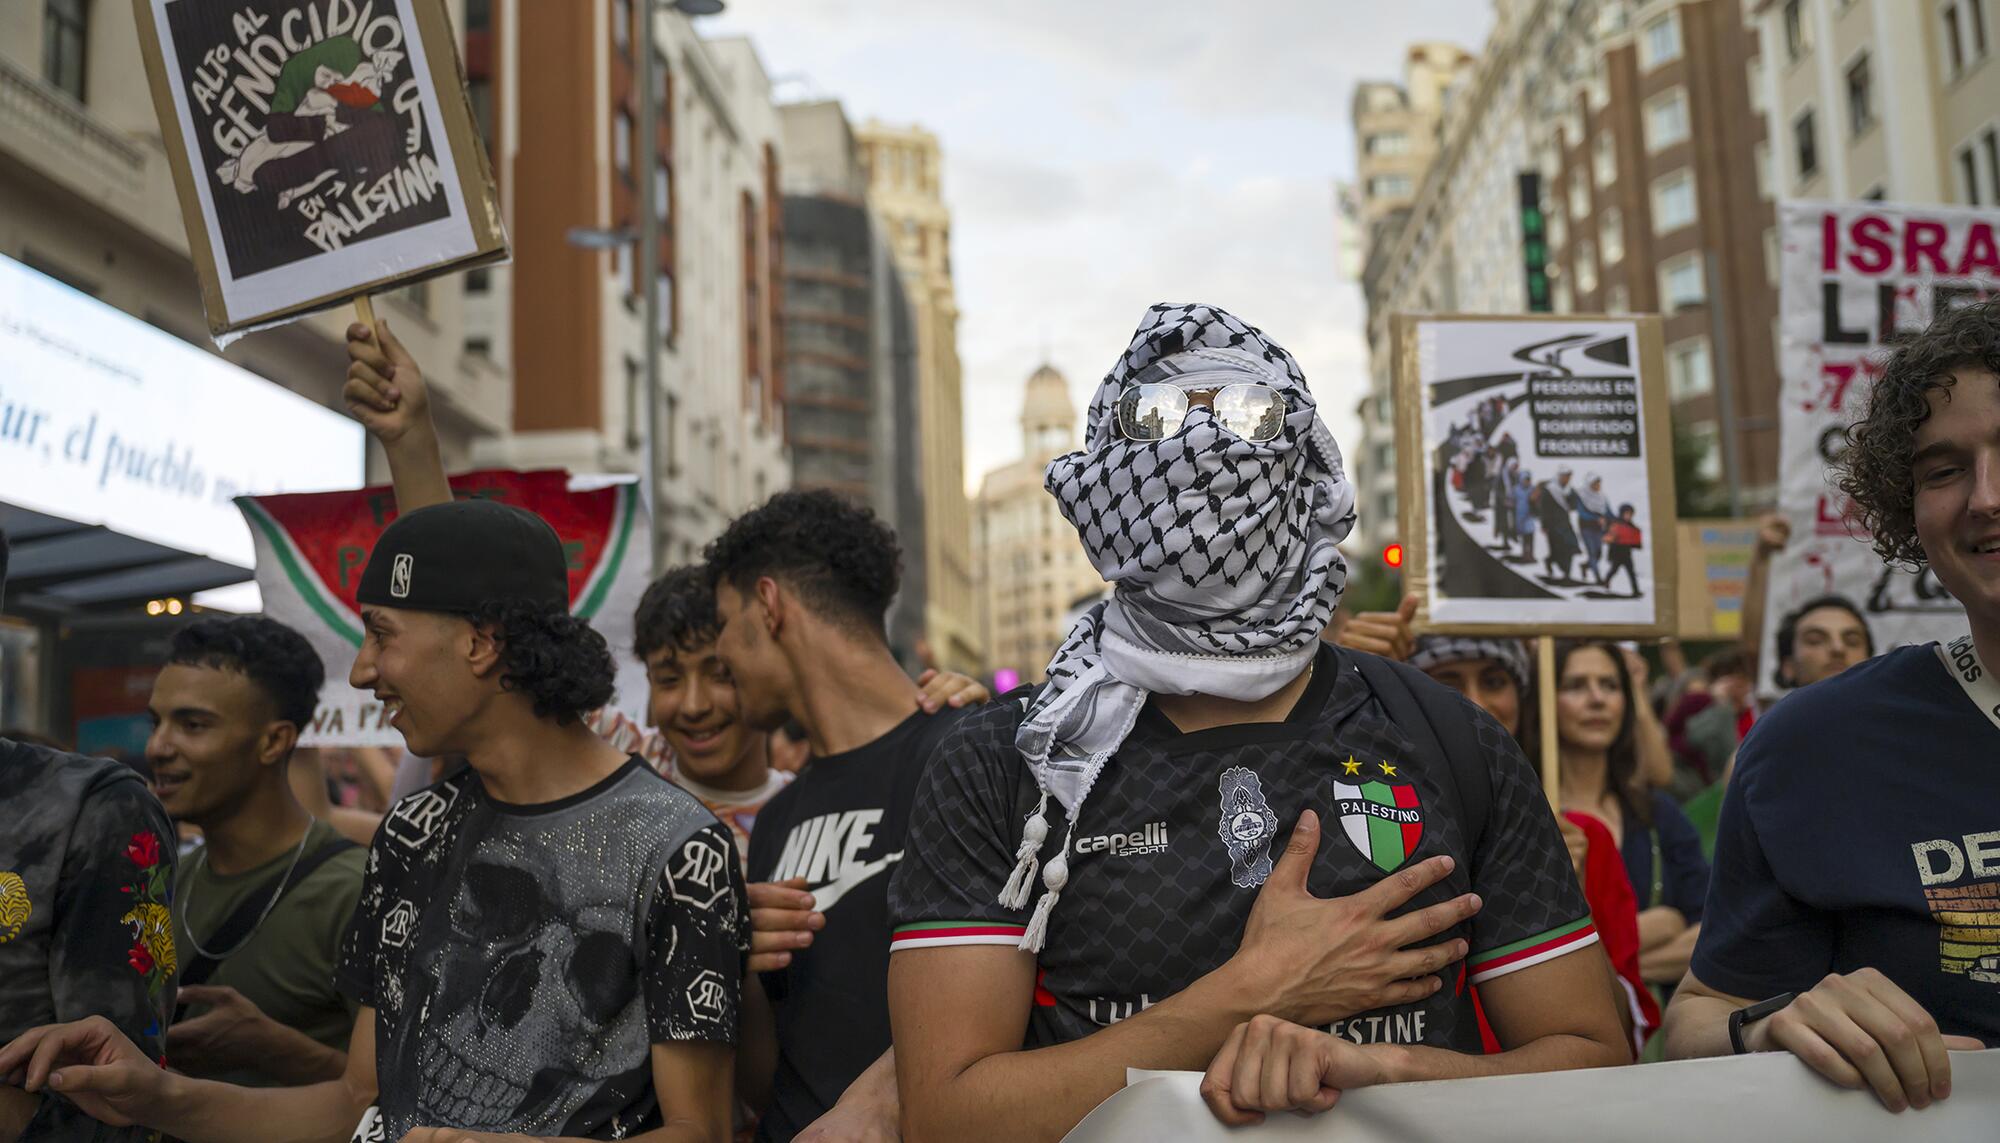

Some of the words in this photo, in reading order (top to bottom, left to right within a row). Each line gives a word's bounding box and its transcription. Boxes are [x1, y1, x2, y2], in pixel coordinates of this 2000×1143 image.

[191, 43, 231, 115] ALTO
[232, 6, 269, 45] AL
[213, 0, 403, 158] GENOCIDIO
[298, 193, 326, 220] EN
[304, 153, 443, 250] PALESTINA
[1531, 380, 1612, 396] PERSONAS
[1614, 380, 1636, 396] EN
[1534, 399, 1636, 415] MOVIMIENTO
[1538, 418, 1635, 435] ROMPIENDO
[1539, 438, 1629, 455] FRONTERAS
[1340, 801, 1420, 823] PALESTINO
[772, 808, 884, 884] NIKE
[1075, 821, 1168, 855] capelli
[1119, 844, 1168, 857] SPORT
[1312, 1010, 1426, 1045] ESTINE
